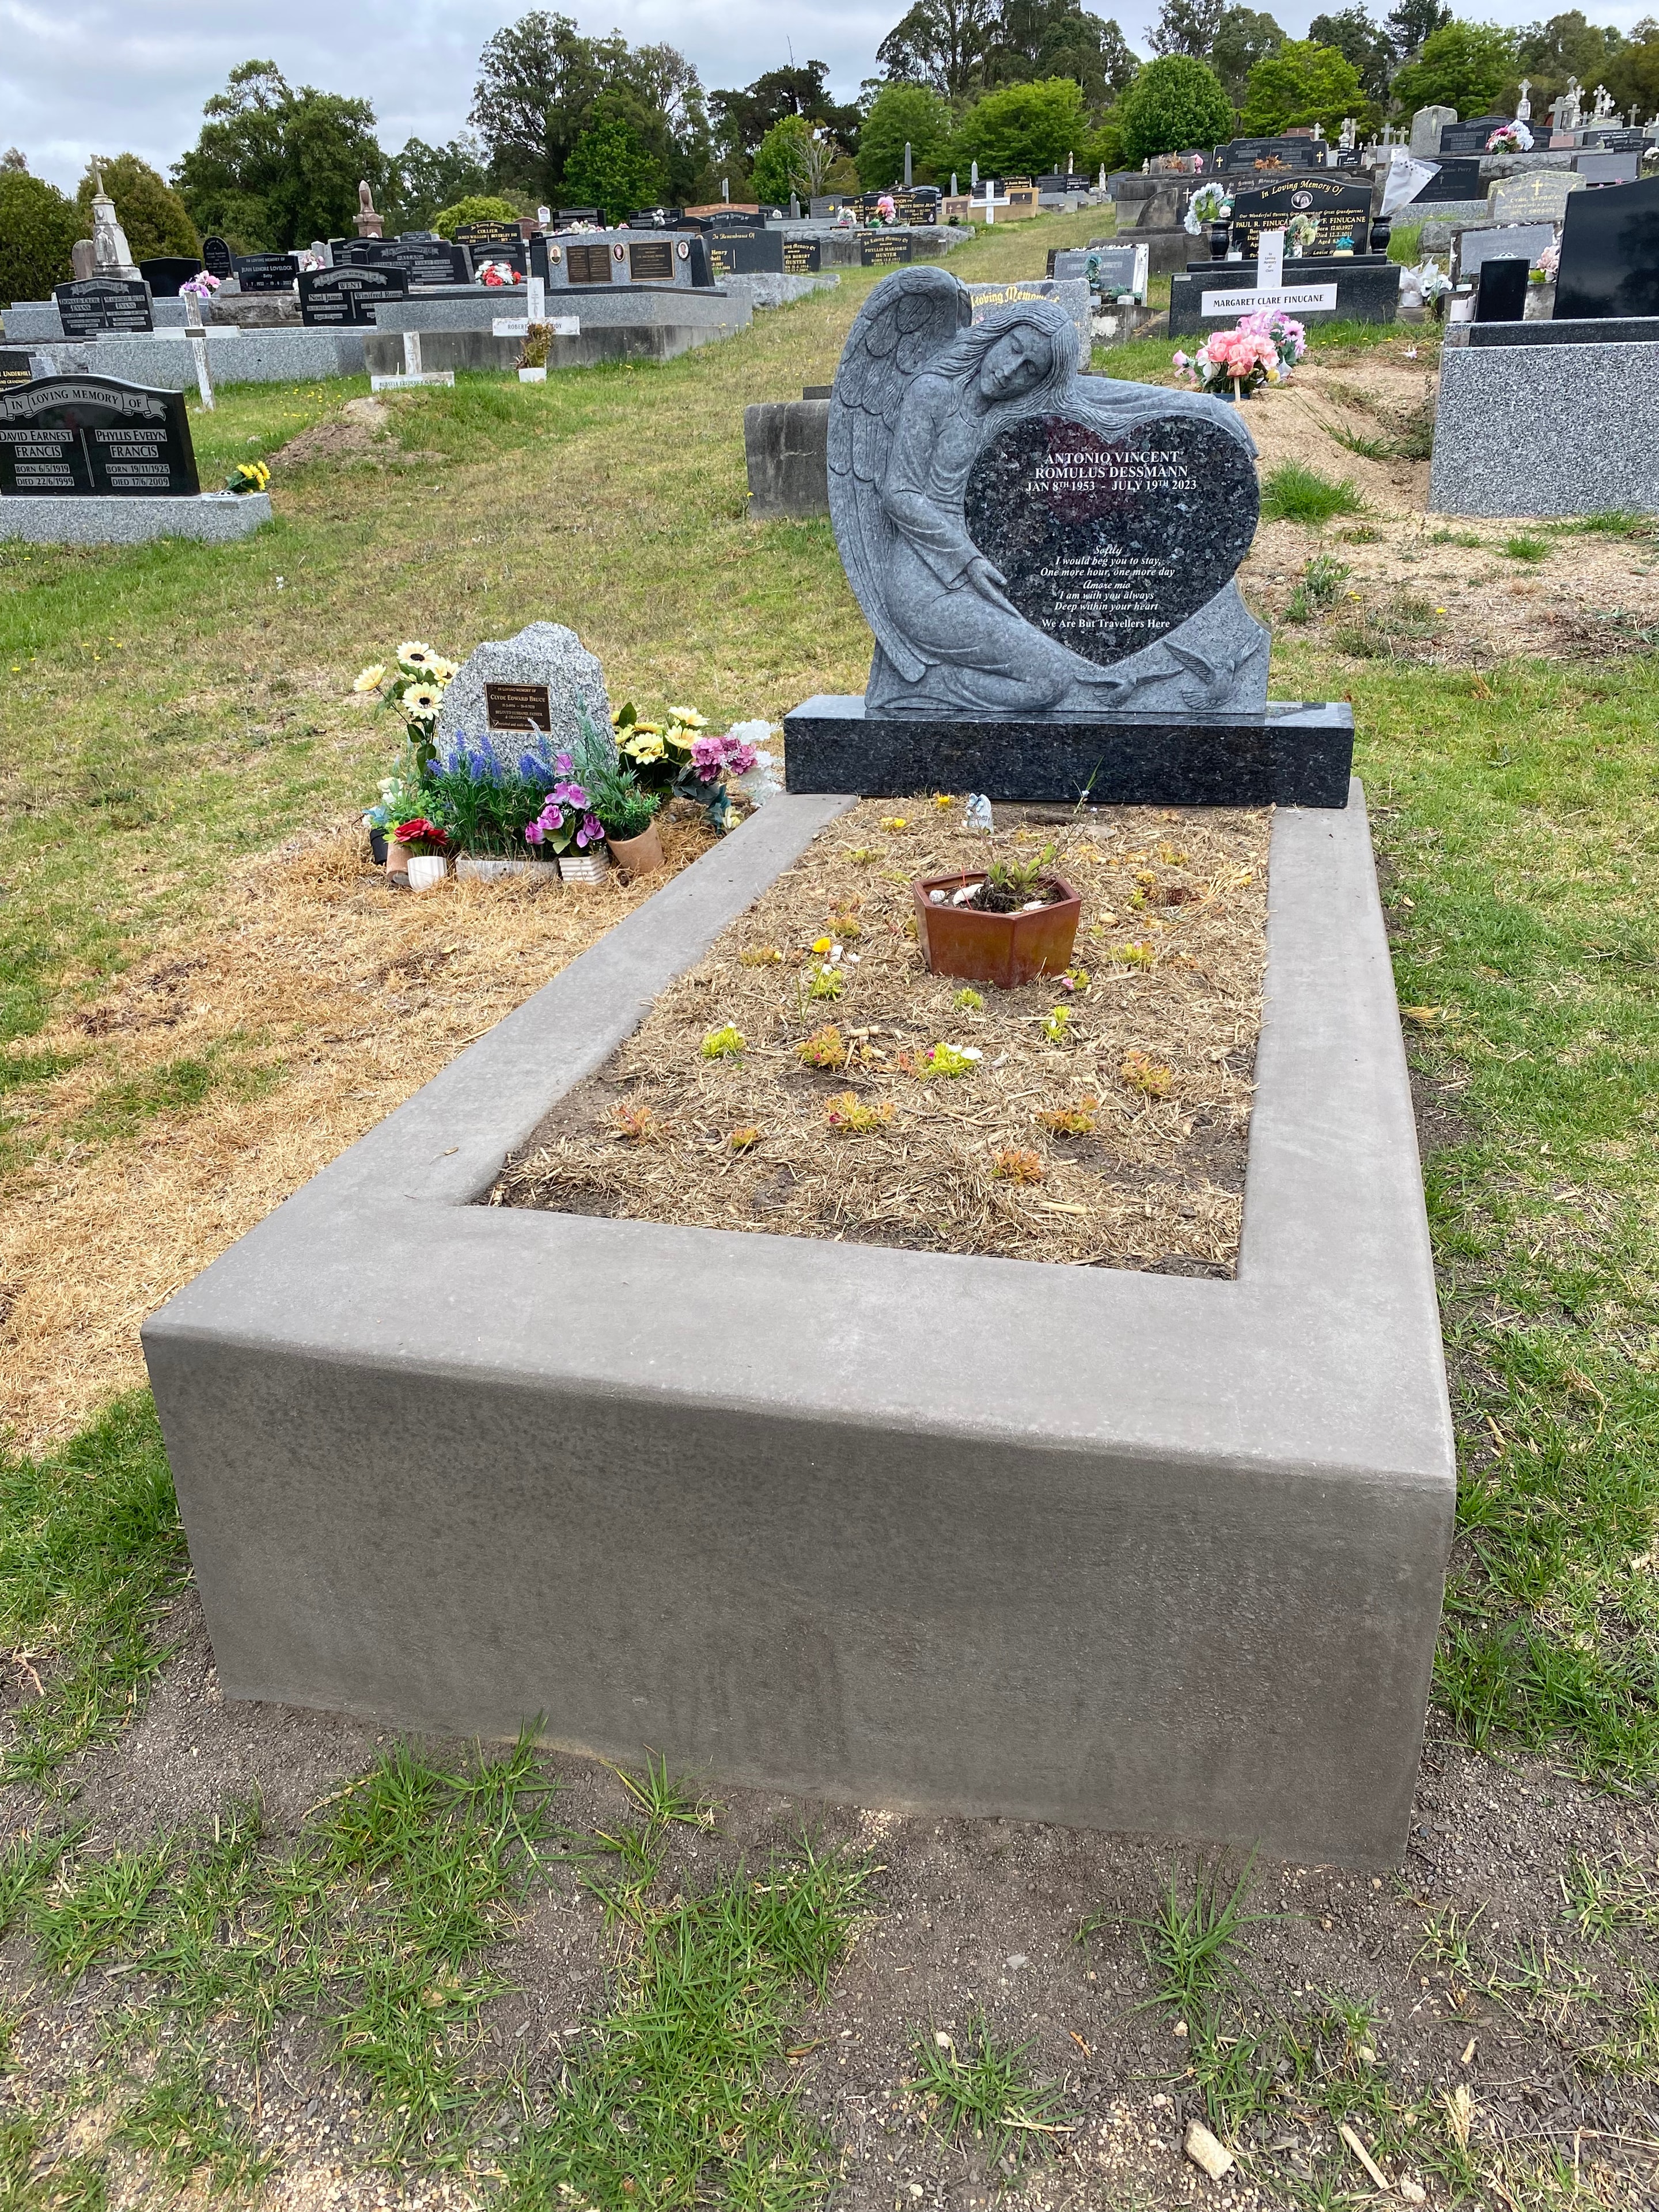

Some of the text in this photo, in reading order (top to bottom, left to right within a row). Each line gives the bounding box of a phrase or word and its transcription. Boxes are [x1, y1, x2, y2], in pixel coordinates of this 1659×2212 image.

[1262, 179, 1344, 199] In Loving Memory Of
[324, 293, 343, 301] James
[1213, 294, 1324, 307] MARGARET CLARE FINUCANE
[12, 389, 142, 410] IN LOVING MEMORY OF
[0, 431, 72, 441] DAVID EARNEST
[97, 431, 166, 441] PHYLLIS EVELYN
[17, 446, 61, 457] FRANCIS
[112, 446, 157, 457] FRANCIS
[1045, 451, 1180, 464] ANTONIO VINCENT
[39, 465, 69, 473] 6/5/1919
[130, 465, 169, 474] 19/11/1925
[1035, 465, 1188, 479] ROMULUS DESSMANN
[37, 478, 74, 486] 22/6/1999
[112, 478, 169, 486] DIED 17/6/2009
[1026, 481, 1049, 491] JAN
[1071, 481, 1095, 491] 1953
[1112, 480, 1143, 490] JULY
[1172, 480, 1196, 490] 2023
[1094, 544, 1123, 556] Softly
[1055, 556, 1060, 565] I
[1063, 556, 1090, 565] would
[1092, 556, 1107, 567] beg
[1109, 558, 1127, 566] you
[1141, 557, 1161, 566] stay,
[1040, 567, 1059, 576] One
[1087, 567, 1111, 577] hour,
[1158, 567, 1175, 578] day
[1083, 579, 1131, 589] Amore mio
[1059, 591, 1065, 599] I
[1083, 591, 1102, 600] with
[1104, 593, 1122, 601] you
[1124, 591, 1154, 600] always
[1054, 602, 1158, 612] Deep within your heart
[1041, 619, 1171, 628] We Are But Travellers Here
